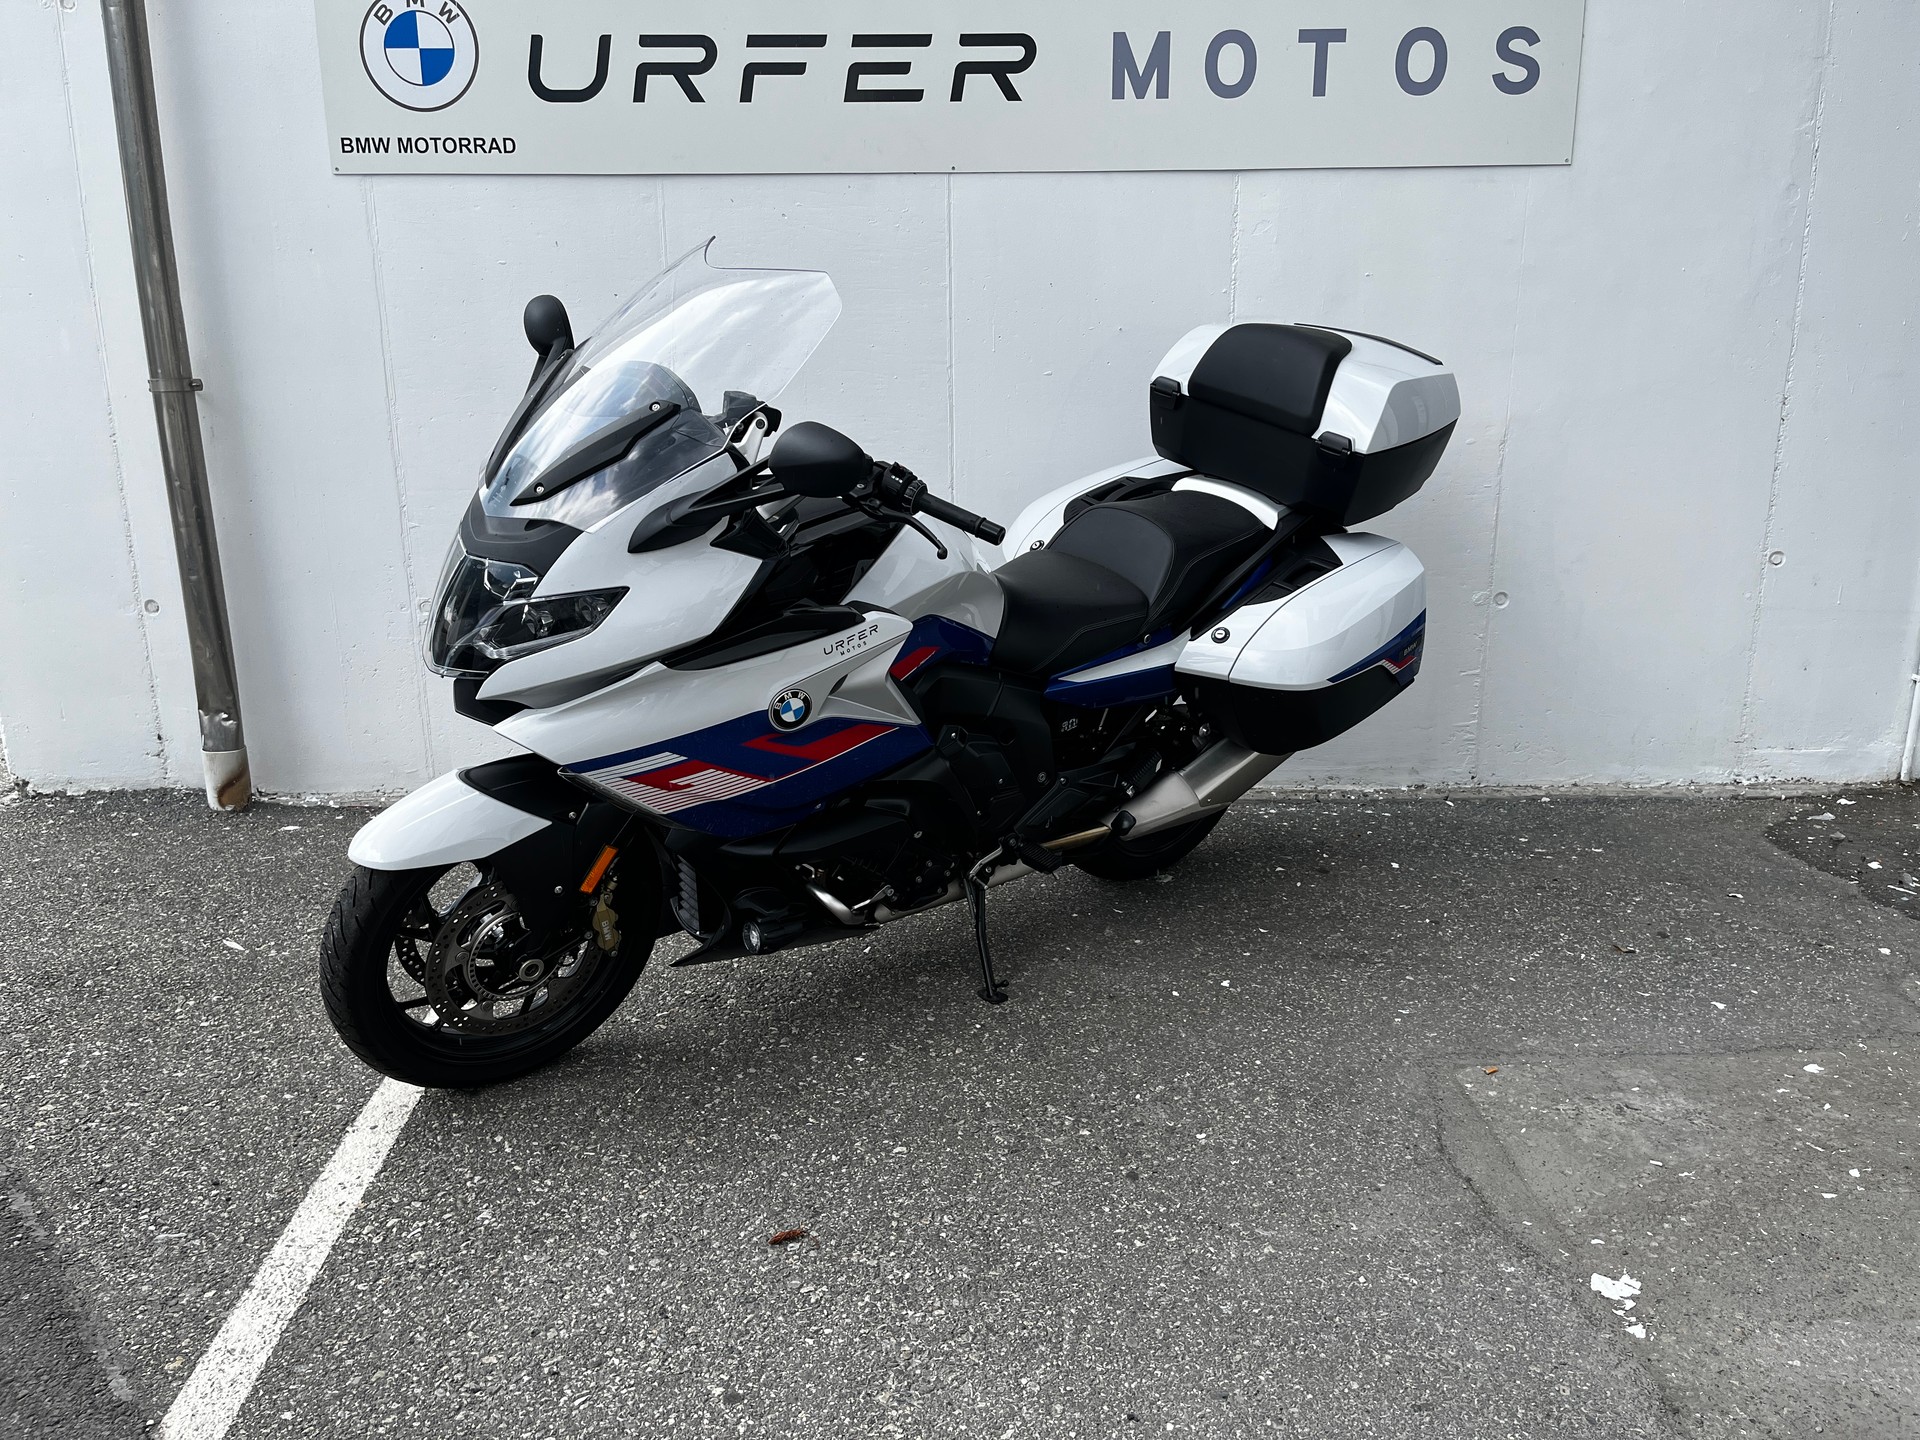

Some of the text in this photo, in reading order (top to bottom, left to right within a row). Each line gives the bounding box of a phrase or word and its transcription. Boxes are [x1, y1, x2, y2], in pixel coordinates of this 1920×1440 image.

[527, 26, 1541, 104] URFER MOTOS
[340, 137, 517, 154] BMW MOTORRAD
[823, 624, 879, 656] URFER
[840, 640, 867, 656] MOTOS
[774, 691, 806, 710] BMW
[601, 919, 612, 941] BMW
